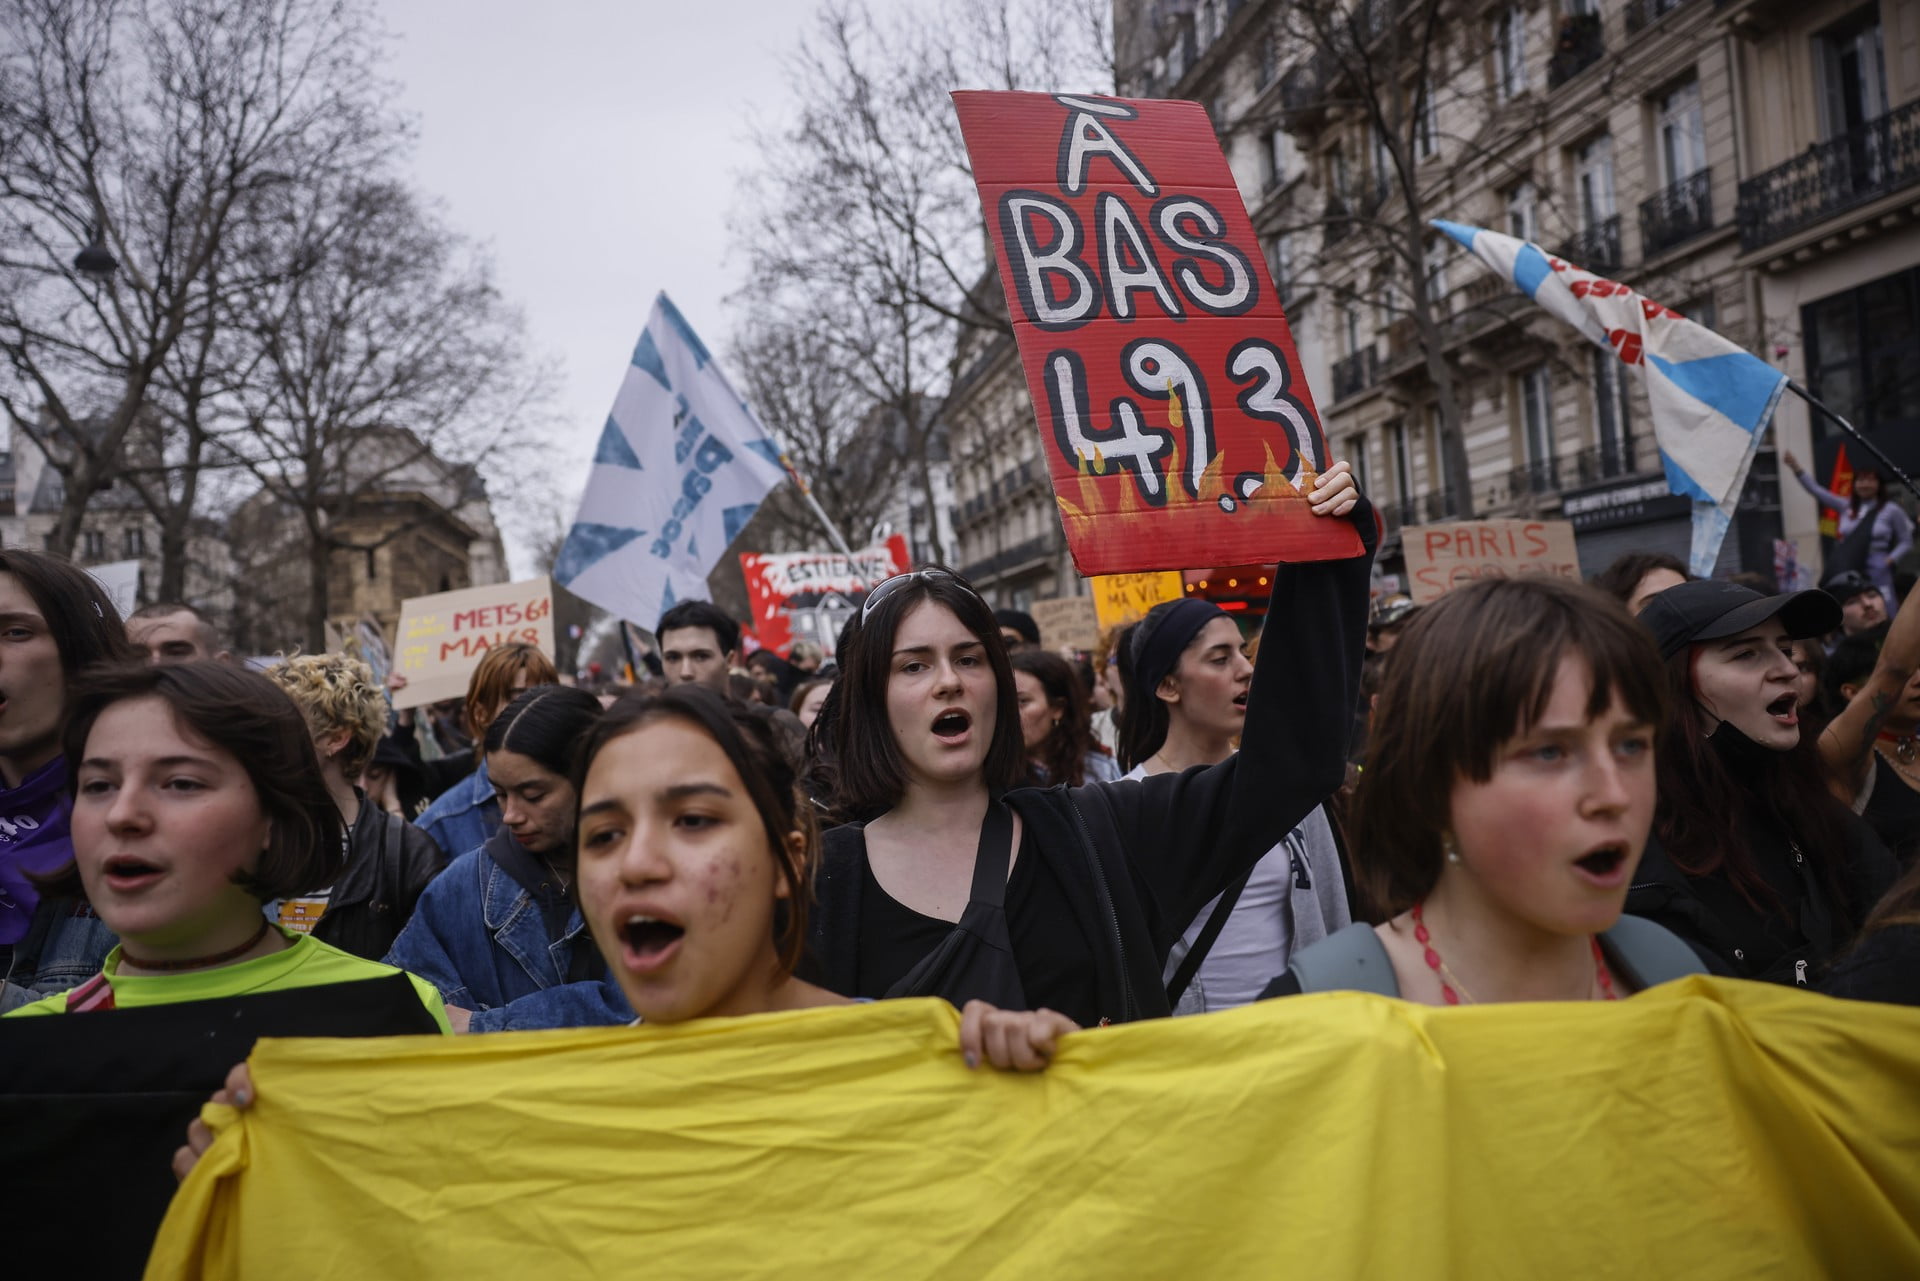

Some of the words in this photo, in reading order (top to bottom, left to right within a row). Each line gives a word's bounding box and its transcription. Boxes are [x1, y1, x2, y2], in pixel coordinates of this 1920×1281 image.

[998, 189, 1260, 332] BAS
[1043, 337, 1325, 514] 49.3
[1425, 524, 1548, 562] PARIS
[1107, 591, 1131, 607] MA
[440, 631, 501, 662] MAI
